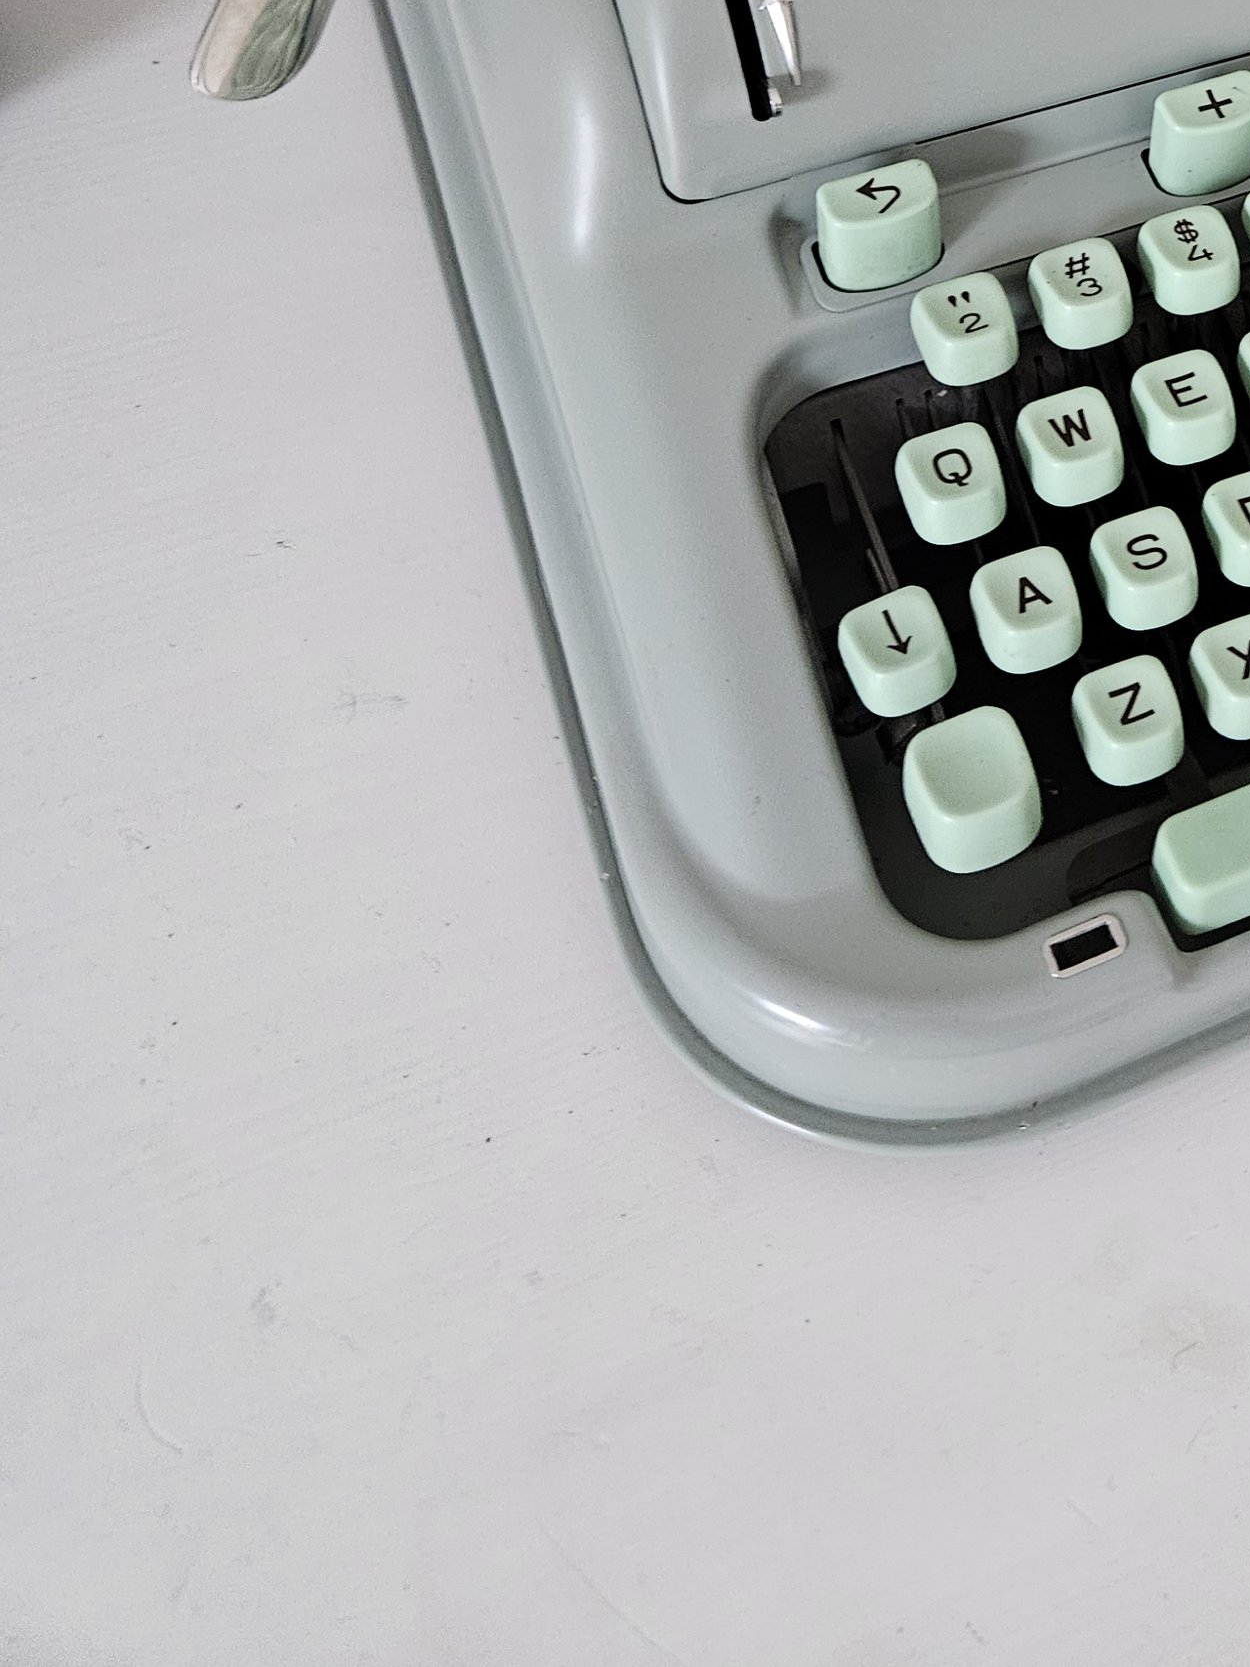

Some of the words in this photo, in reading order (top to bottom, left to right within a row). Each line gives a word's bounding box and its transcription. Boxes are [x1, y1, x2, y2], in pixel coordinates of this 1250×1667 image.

[1174, 219, 1198, 244] $
[1065, 253, 1090, 279] #
[1188, 245, 1213, 261] 4
[1077, 278, 1102, 297] 3
[959, 313, 989, 333] 2
[1164, 372, 1207, 407] E
[1048, 409, 1091, 447] W
[933, 449, 972, 487] Q
[1127, 534, 1167, 570] S
[1019, 577, 1053, 614] A
[1108, 682, 1155, 725] Z
